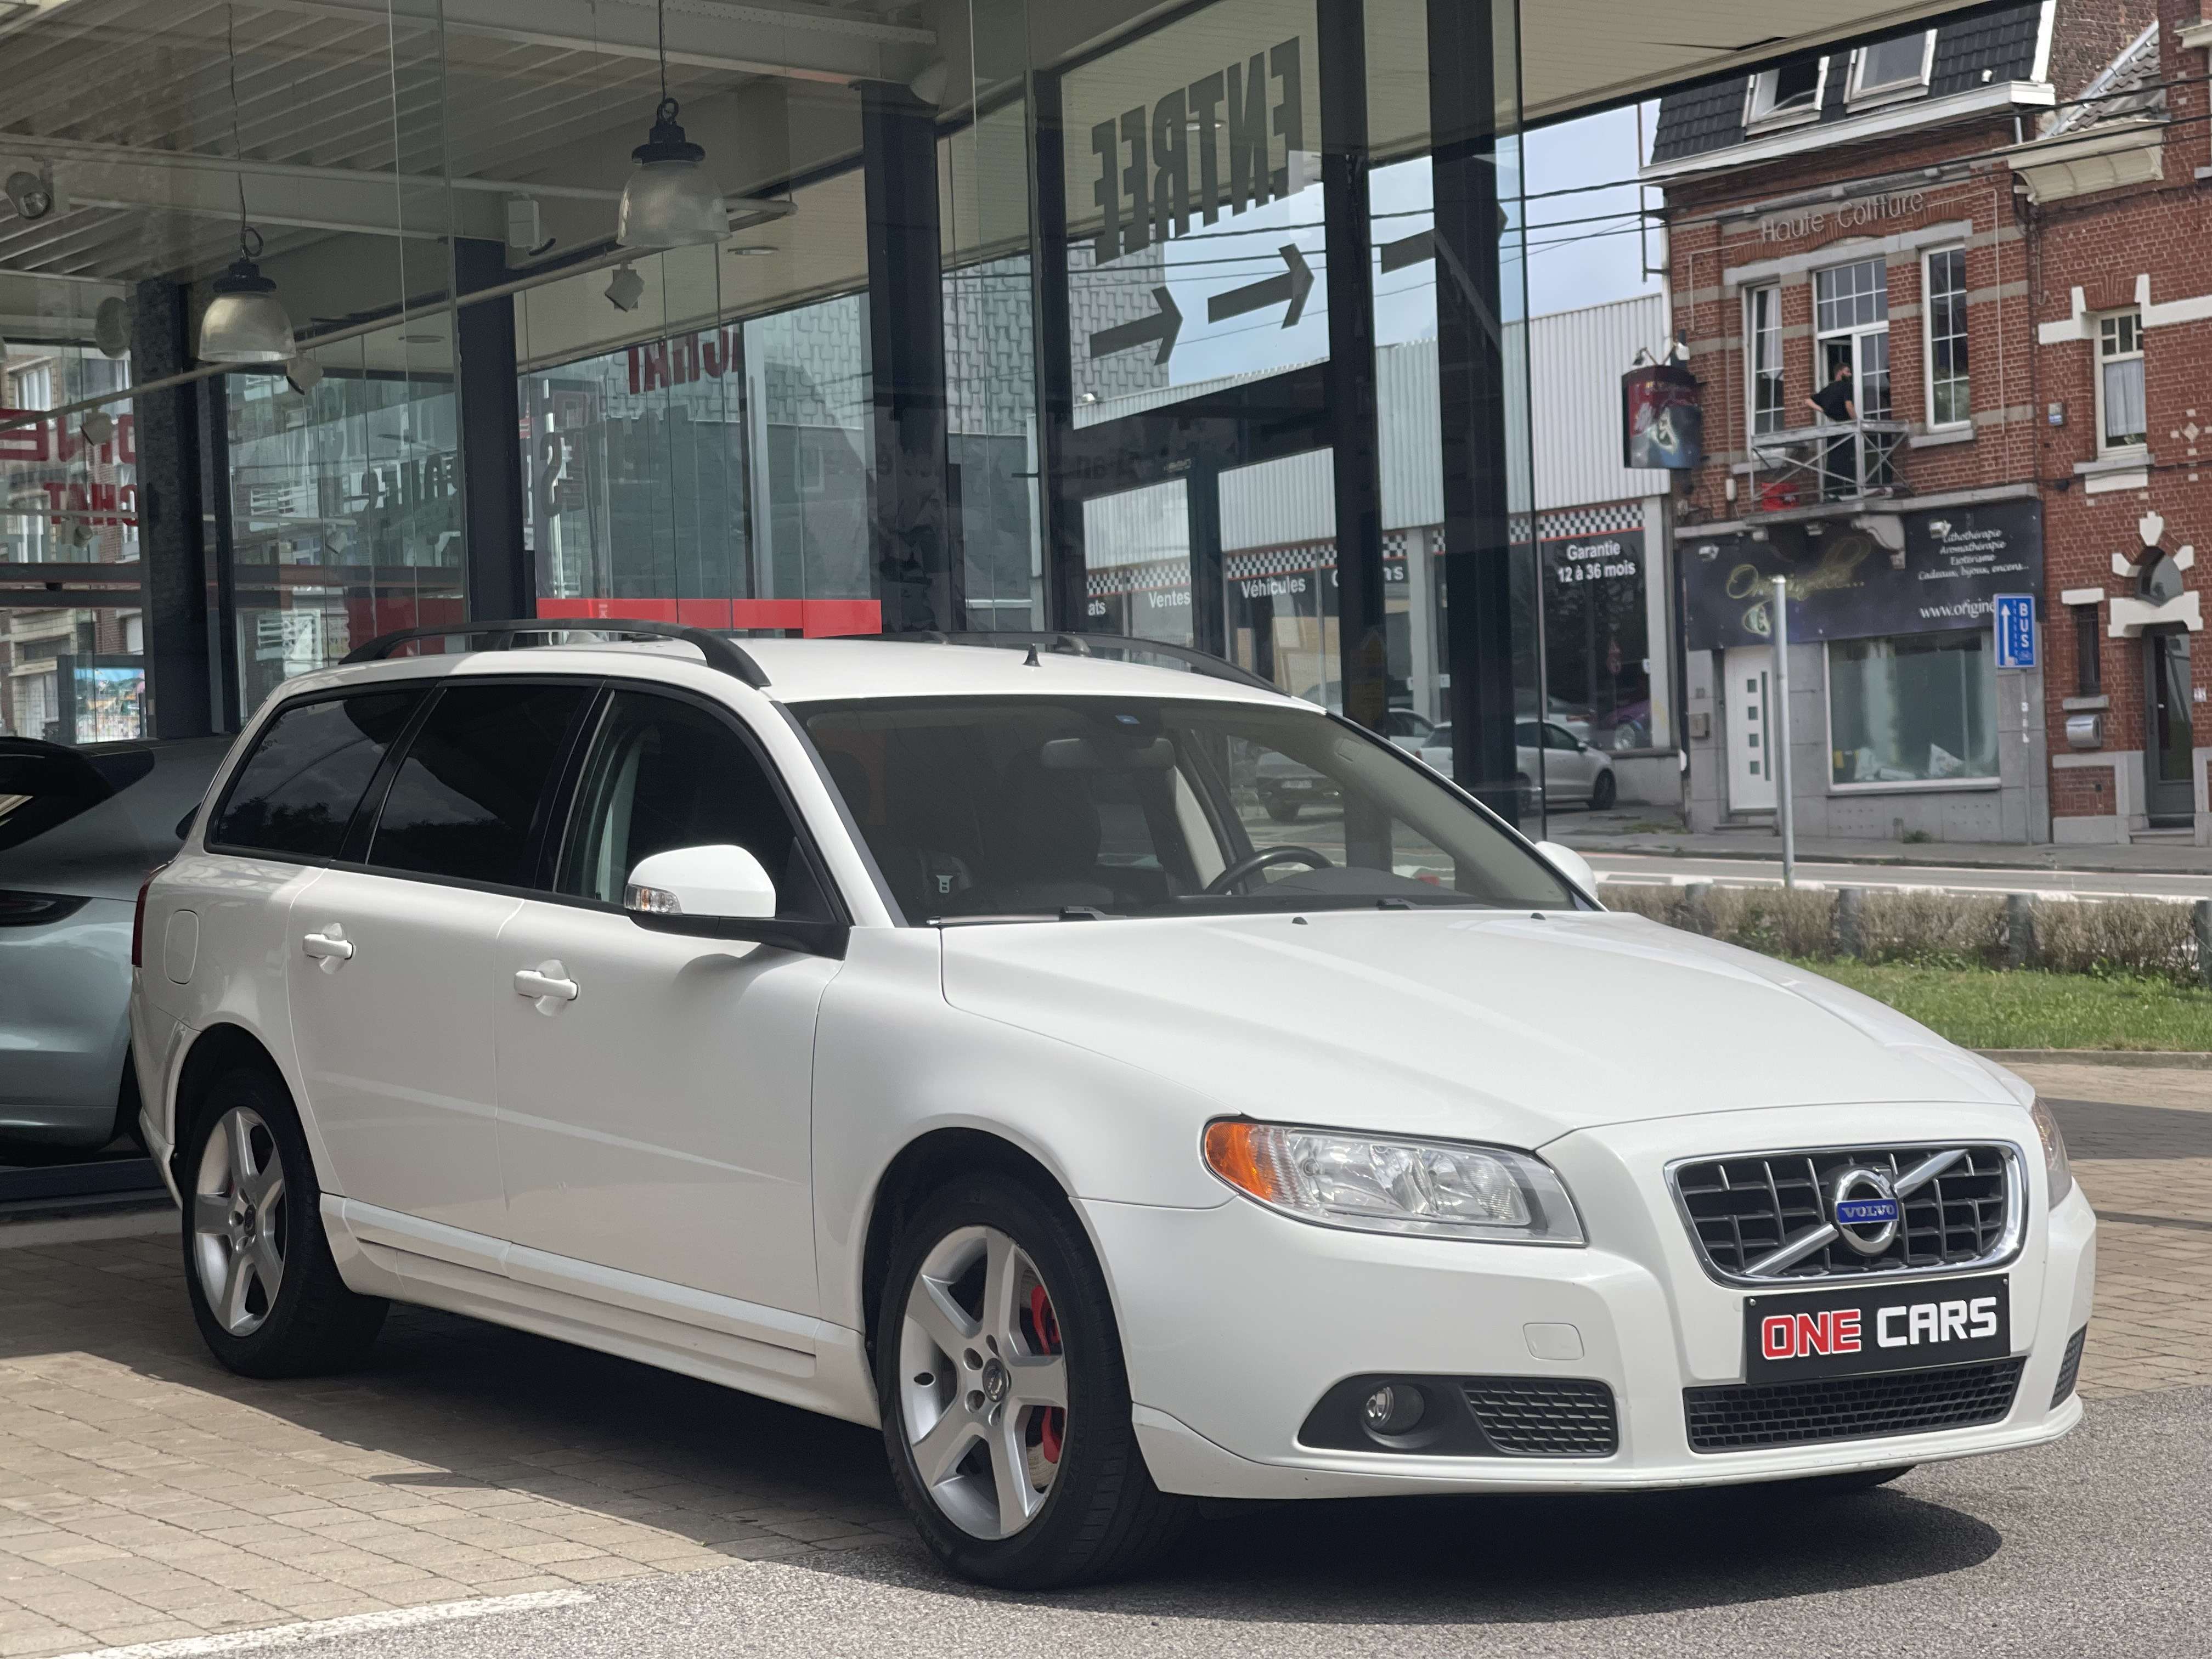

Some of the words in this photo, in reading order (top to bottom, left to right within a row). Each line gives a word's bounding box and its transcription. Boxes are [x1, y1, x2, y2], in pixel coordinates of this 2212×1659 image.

[1760, 211, 1825, 243] Haute
[1566, 540, 1621, 561] Garantie
[1558, 566, 1573, 583] 12
[1575, 565, 1583, 581] à
[1586, 563, 1601, 580] 36
[1604, 560, 1636, 577] mois
[1148, 590, 1190, 608] Ventes
[1241, 576, 1306, 599] Véhicules
[2018, 603, 2030, 648] BUS
[1841, 1204, 1896, 1218] VOLVO
[1762, 1308, 1861, 1361] ONE
[1876, 1296, 1997, 1348] CARS
